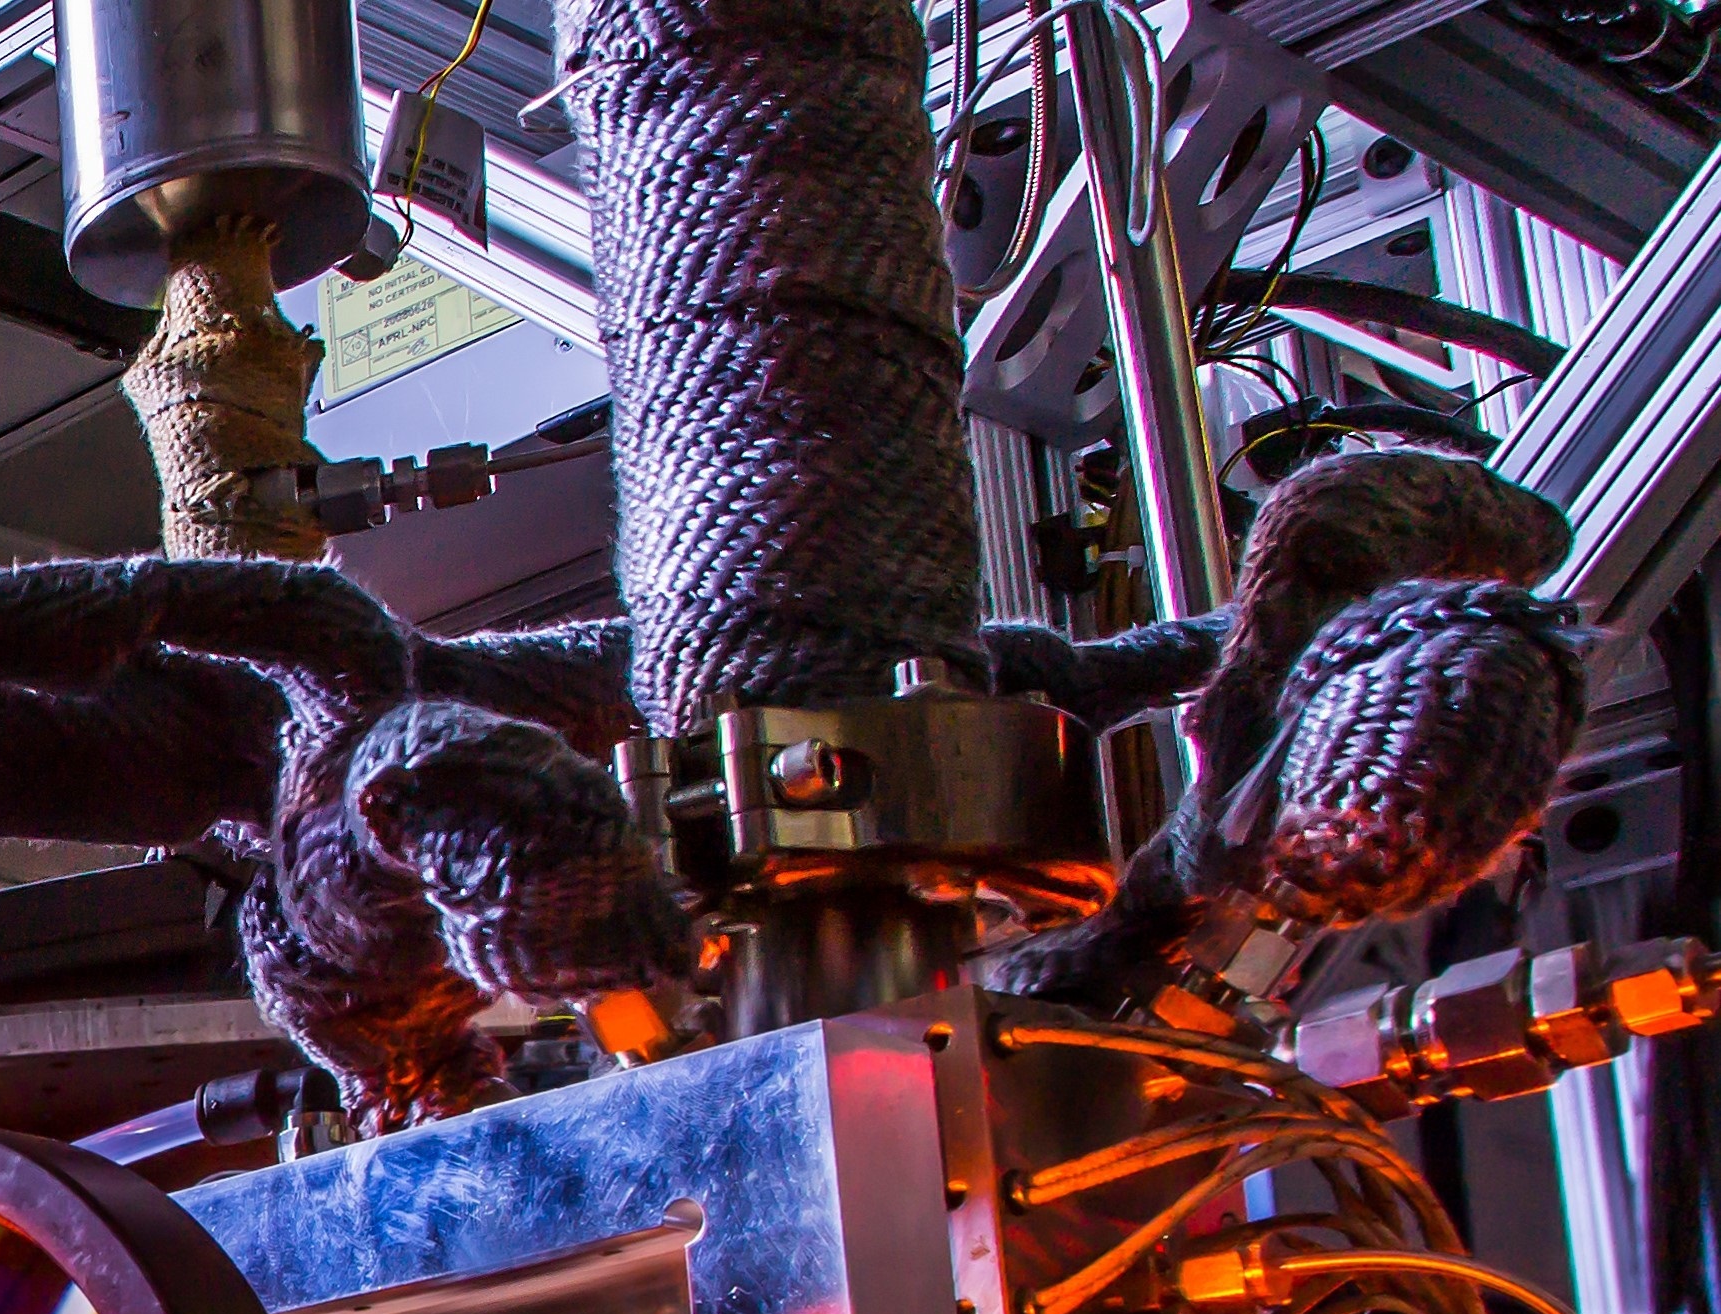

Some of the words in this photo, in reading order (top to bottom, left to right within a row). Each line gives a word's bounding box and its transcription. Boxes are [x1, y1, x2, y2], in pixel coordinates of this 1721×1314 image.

[368, 286, 383, 298] NO
[385, 271, 418, 291] INITIAL
[368, 299, 384, 311] NO
[385, 275, 434, 304] CERTIFIED
